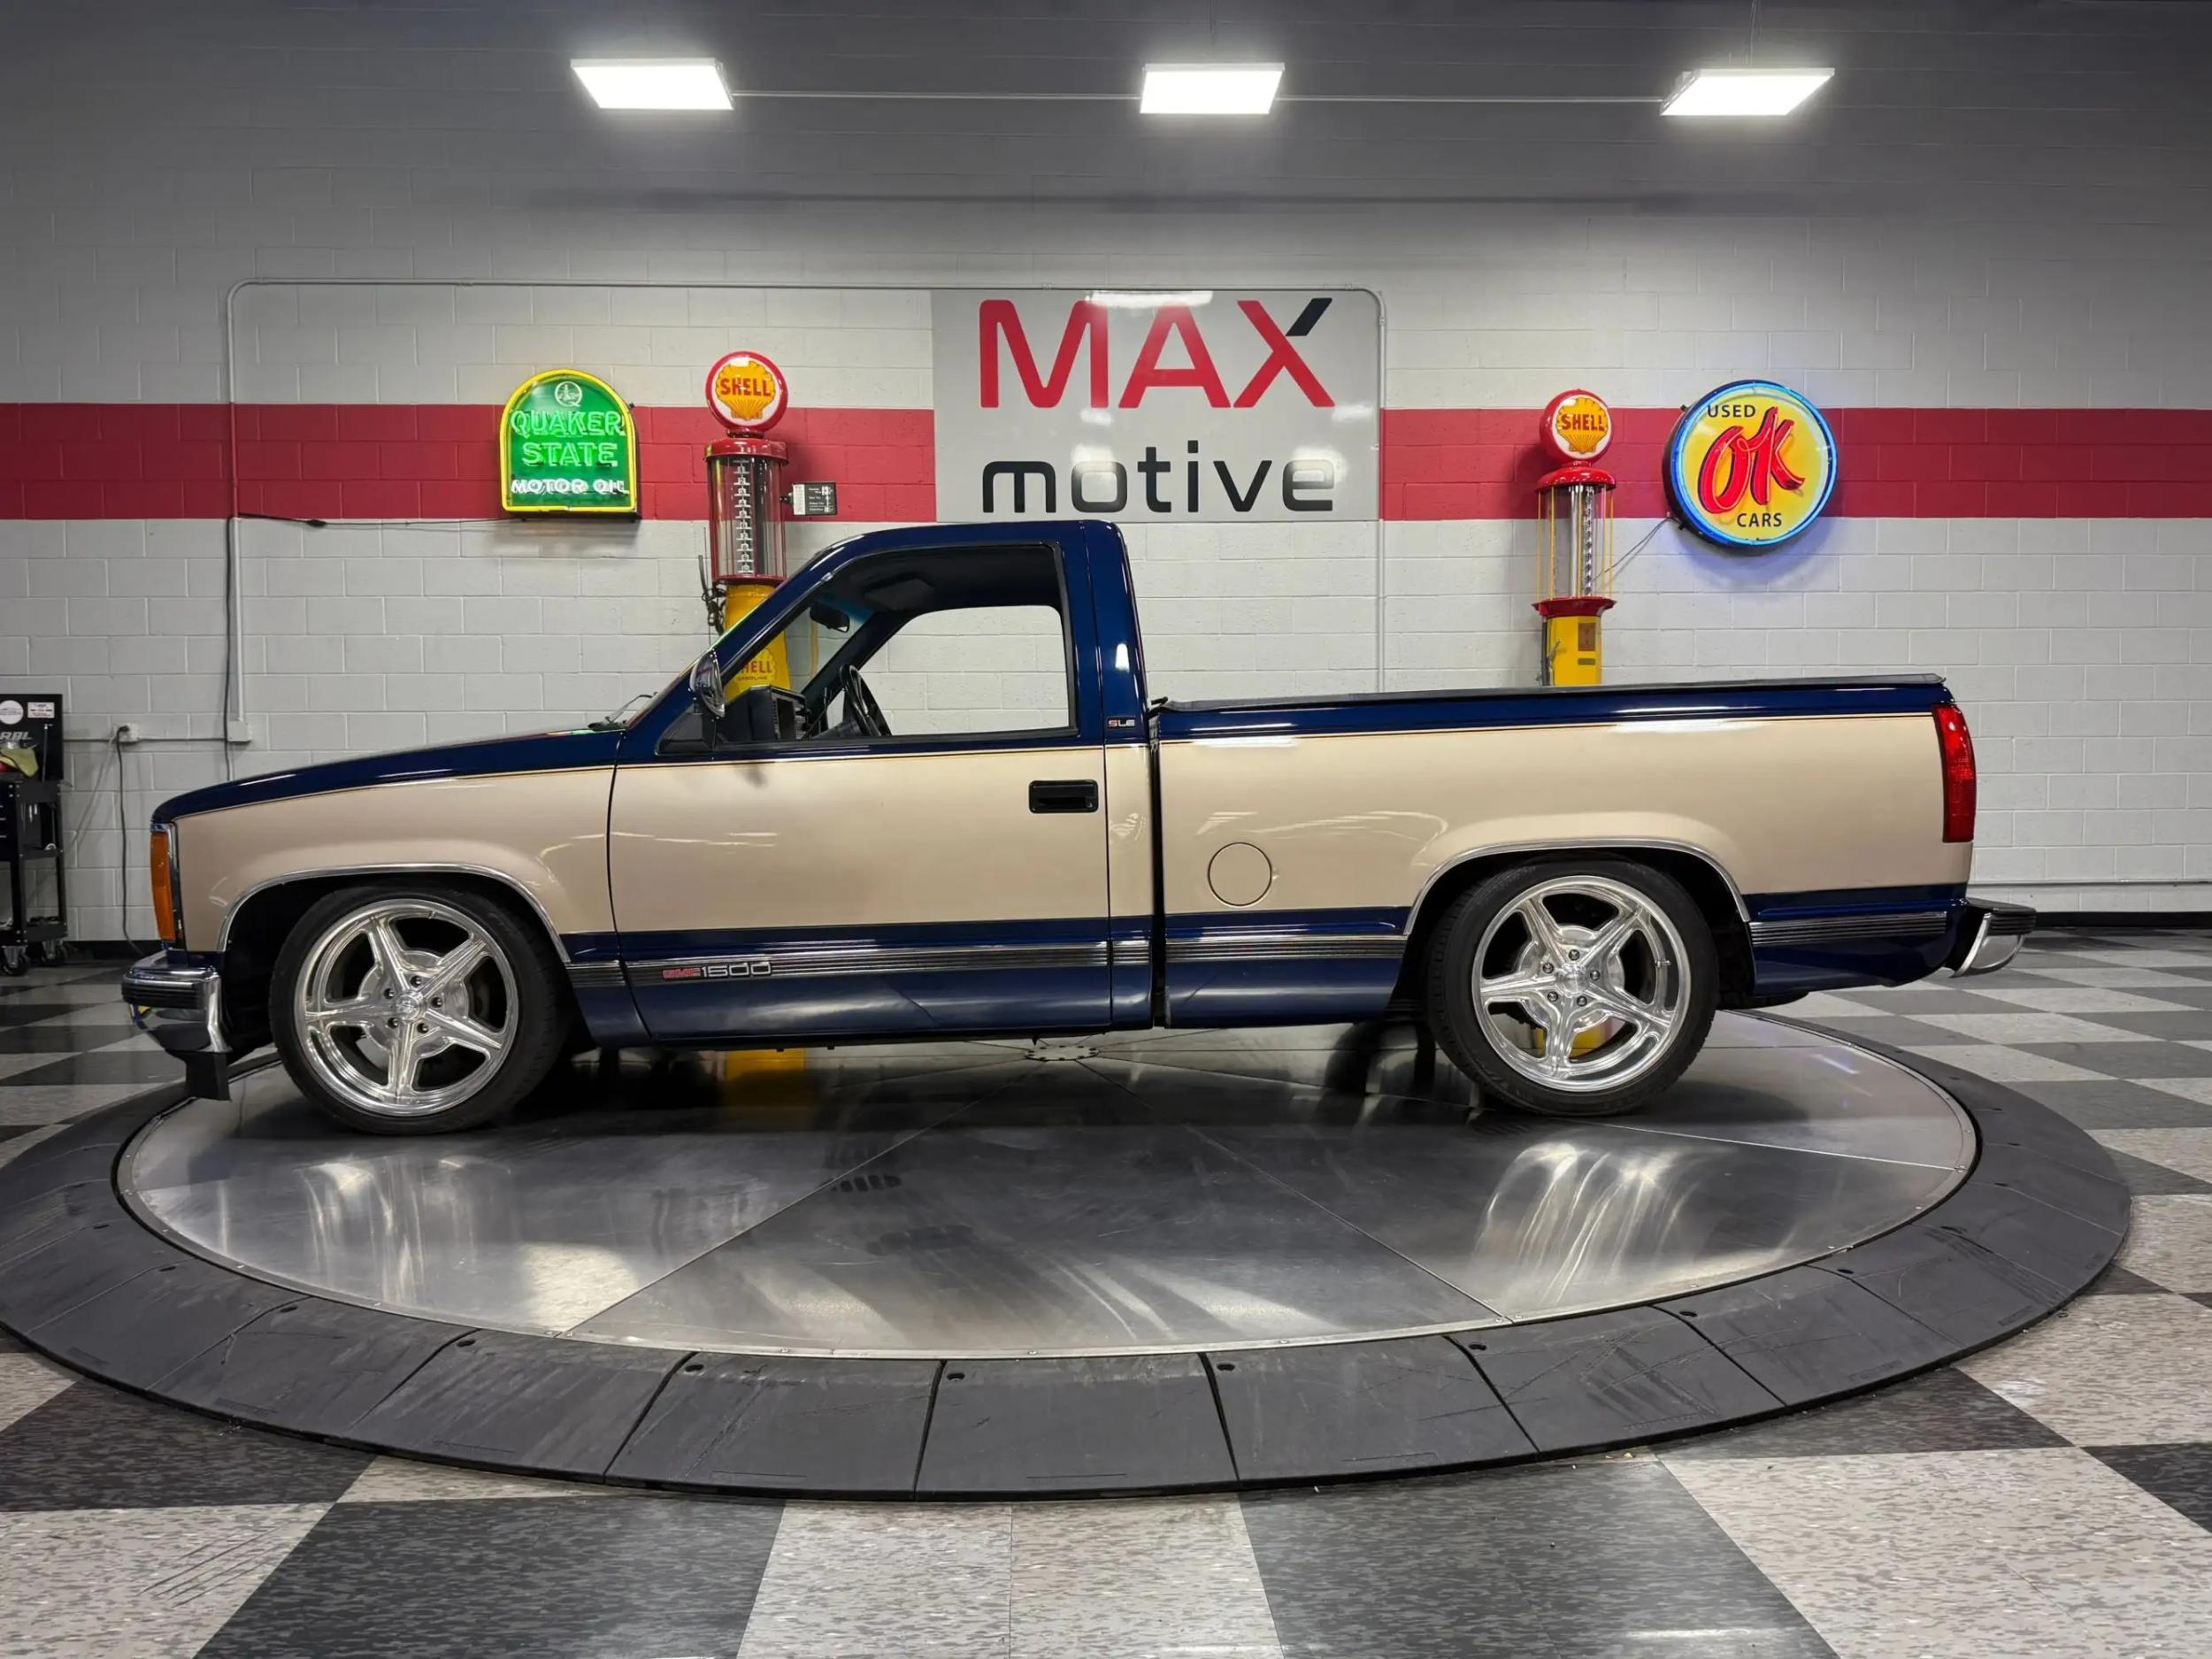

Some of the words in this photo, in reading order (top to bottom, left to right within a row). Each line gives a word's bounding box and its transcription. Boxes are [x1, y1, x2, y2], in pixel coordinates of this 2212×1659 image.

[979, 297, 1335, 408] MAX
[720, 378, 771, 396] SHELL
[1707, 404, 1755, 418] USED
[511, 410, 626, 439] QUAKER
[1561, 413, 1604, 431] SHELL
[522, 442, 618, 466] STATE
[1698, 406, 1805, 514] OK
[982, 440, 1334, 513] motive
[511, 479, 589, 495] MOTOR
[593, 479, 630, 495] OIL
[1737, 513, 1782, 527] CARS
[702, 962, 771, 977] 1500
